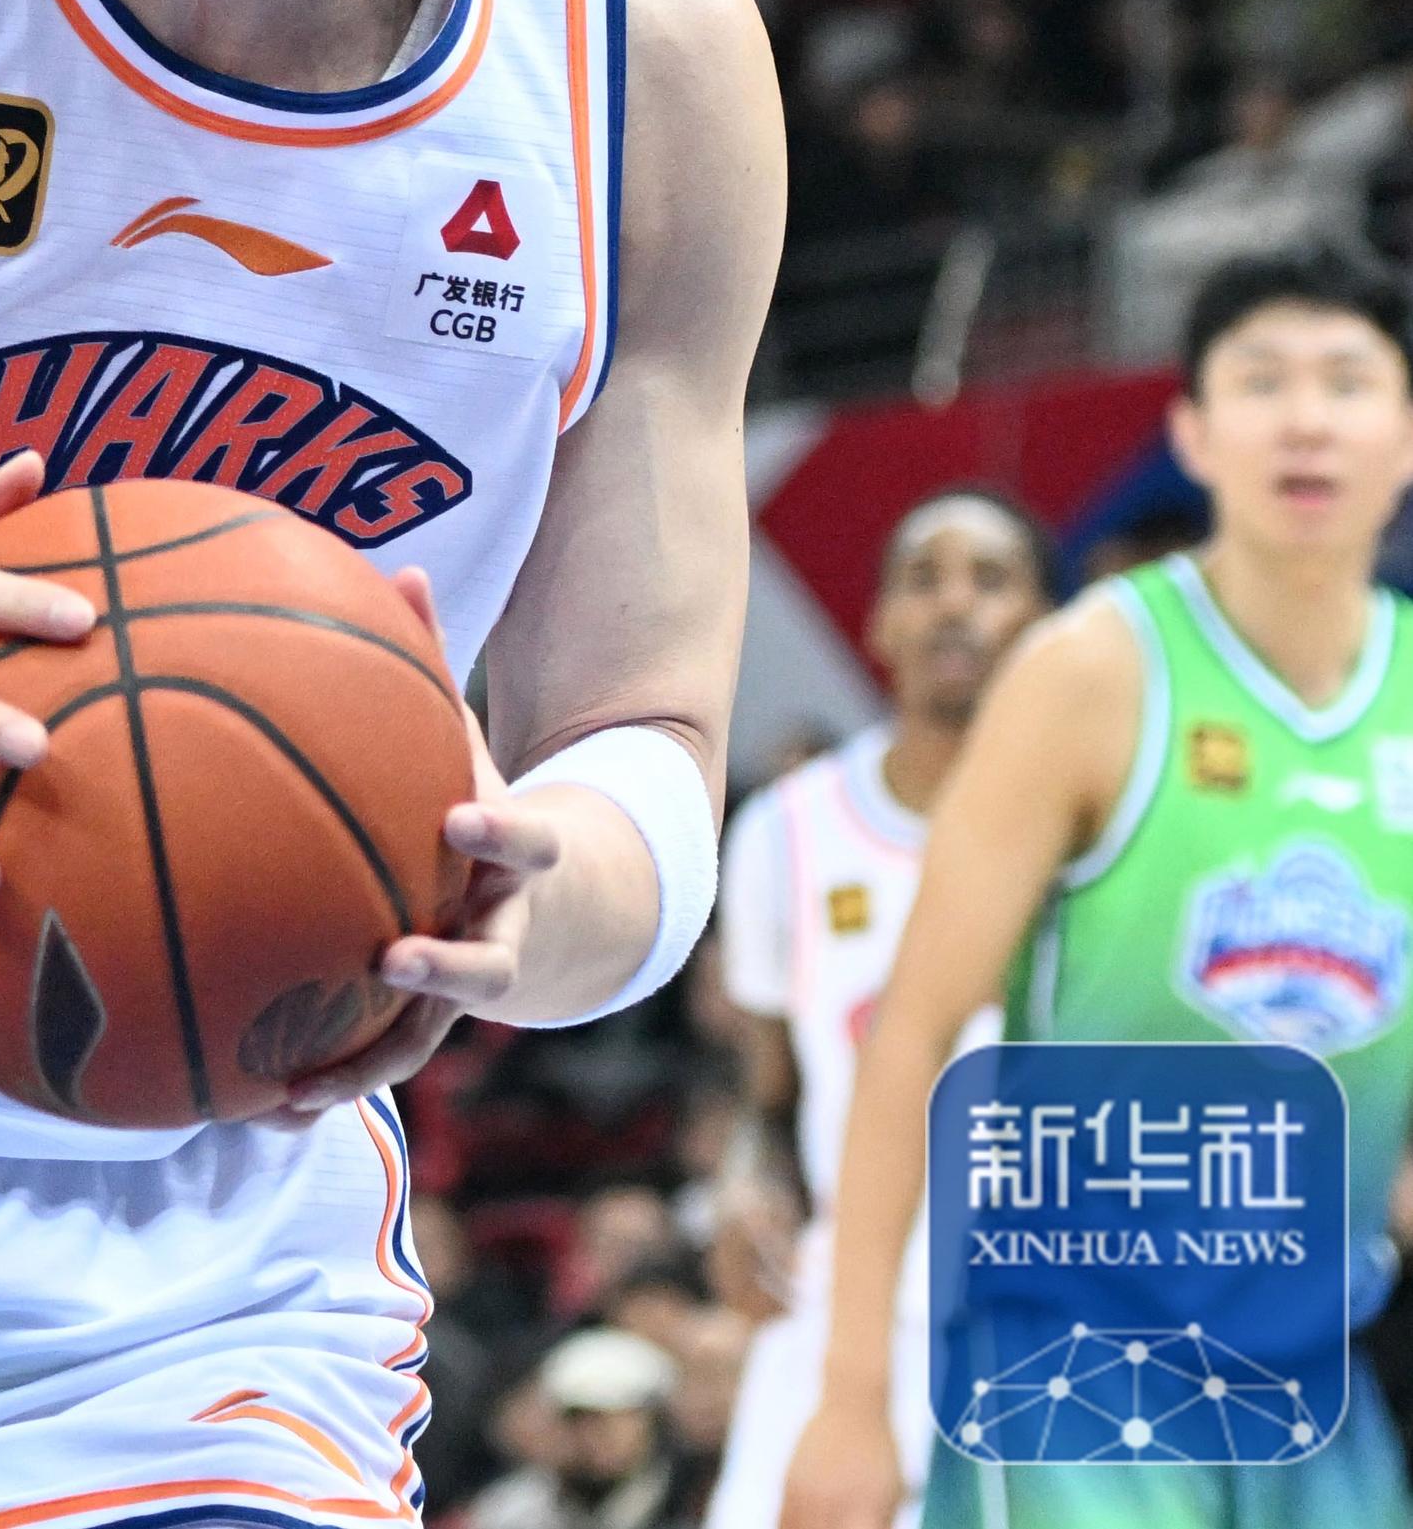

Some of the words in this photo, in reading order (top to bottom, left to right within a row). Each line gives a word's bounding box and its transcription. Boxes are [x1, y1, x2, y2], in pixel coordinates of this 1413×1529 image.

[414, 272, 525, 312] 广发银行
[429, 309, 497, 343] CGB
